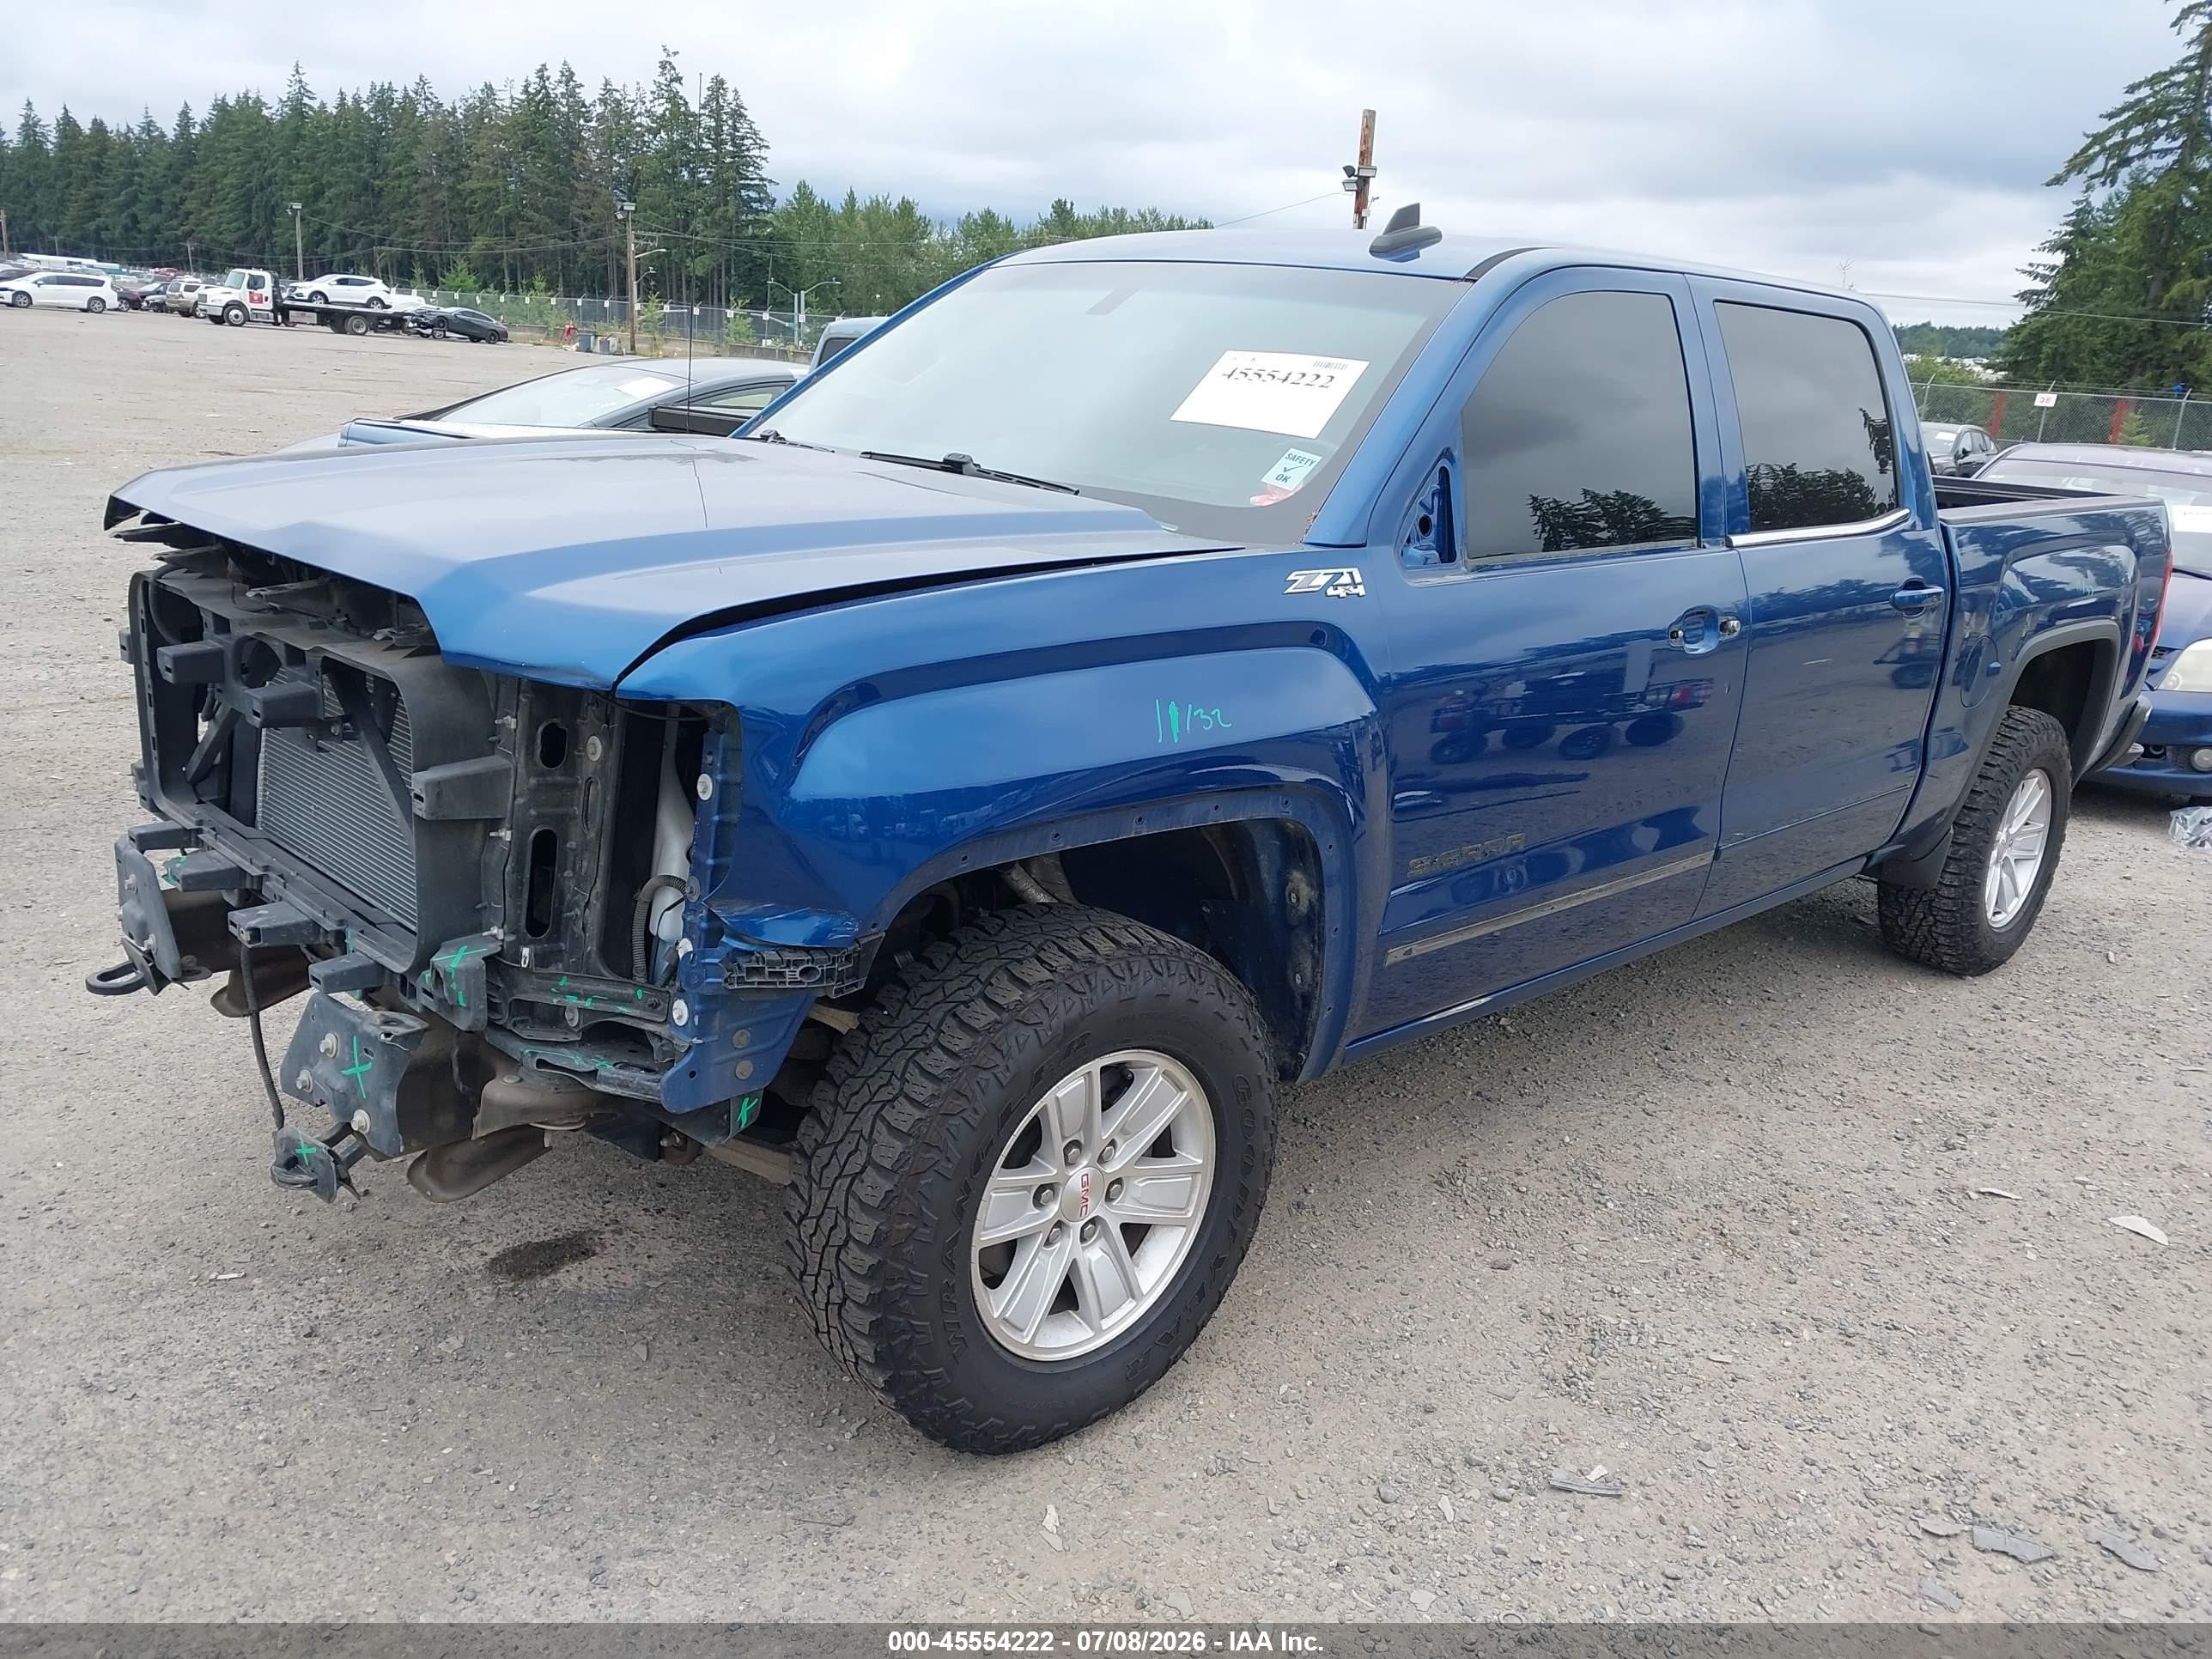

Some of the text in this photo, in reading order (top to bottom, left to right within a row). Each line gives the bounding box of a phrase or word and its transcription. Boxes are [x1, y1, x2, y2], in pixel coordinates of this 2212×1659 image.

[1222, 367, 1335, 388] 45554222
[1285, 453, 1317, 466] SAFETY
[1275, 473, 1291, 483] OK
[1283, 567, 1362, 594] Z71
[1407, 833, 1526, 877] SIERRA
[939, 1031, 1092, 1364] WRANGLER
[1079, 1173, 1090, 1218] GMC
[1124, 1073, 1259, 1381] GOODYEAR
